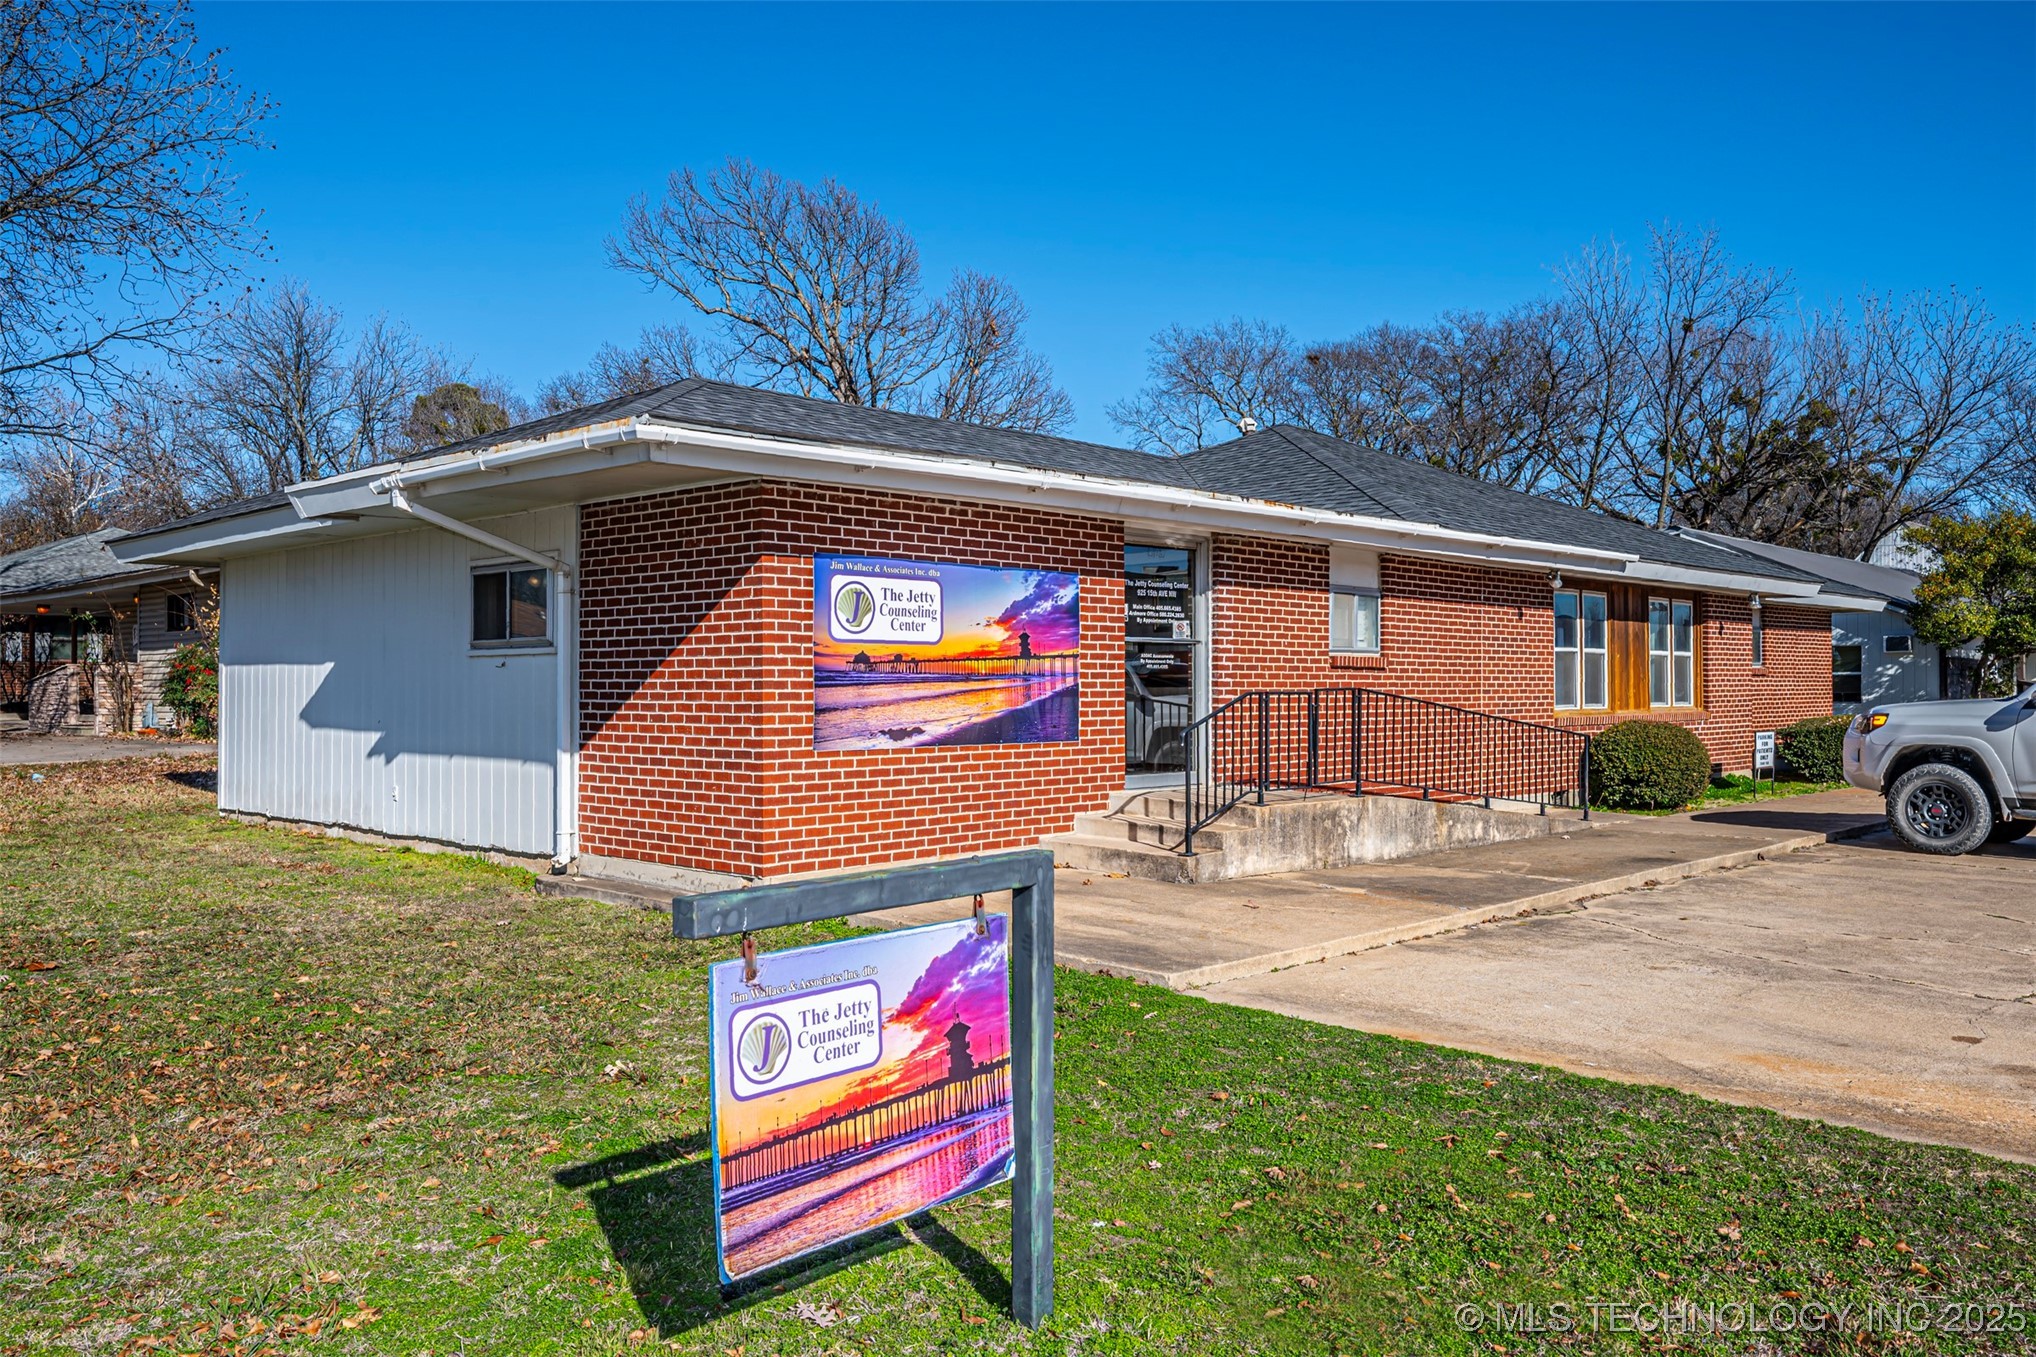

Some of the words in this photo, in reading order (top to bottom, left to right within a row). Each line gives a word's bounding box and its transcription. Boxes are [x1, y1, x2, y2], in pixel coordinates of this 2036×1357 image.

[830, 561, 844, 570] Jim
[846, 562, 872, 572] Wallace
[874, 564, 880, 572] &
[883, 566, 914, 575] Associates
[1135, 580, 1146, 588] Jetty
[1148, 580, 1172, 589] Counseling
[846, 591, 864, 624] J
[881, 588, 904, 602] The
[906, 590, 936, 607] Jetty
[880, 602, 938, 622] Counseling
[890, 618, 926, 632] Center
[730, 992, 748, 1004] Jim
[750, 984, 786, 999] Wallace
[788, 981, 798, 992] &
[797, 974, 842, 990] Associates
[844, 970, 860, 981] Inc.
[862, 966, 878, 977] dba
[798, 1008, 830, 1028] The
[834, 1000, 872, 1020] Jetty
[798, 1020, 875, 1049] Counseling
[753, 1024, 776, 1072] J
[813, 1041, 860, 1064] Center
